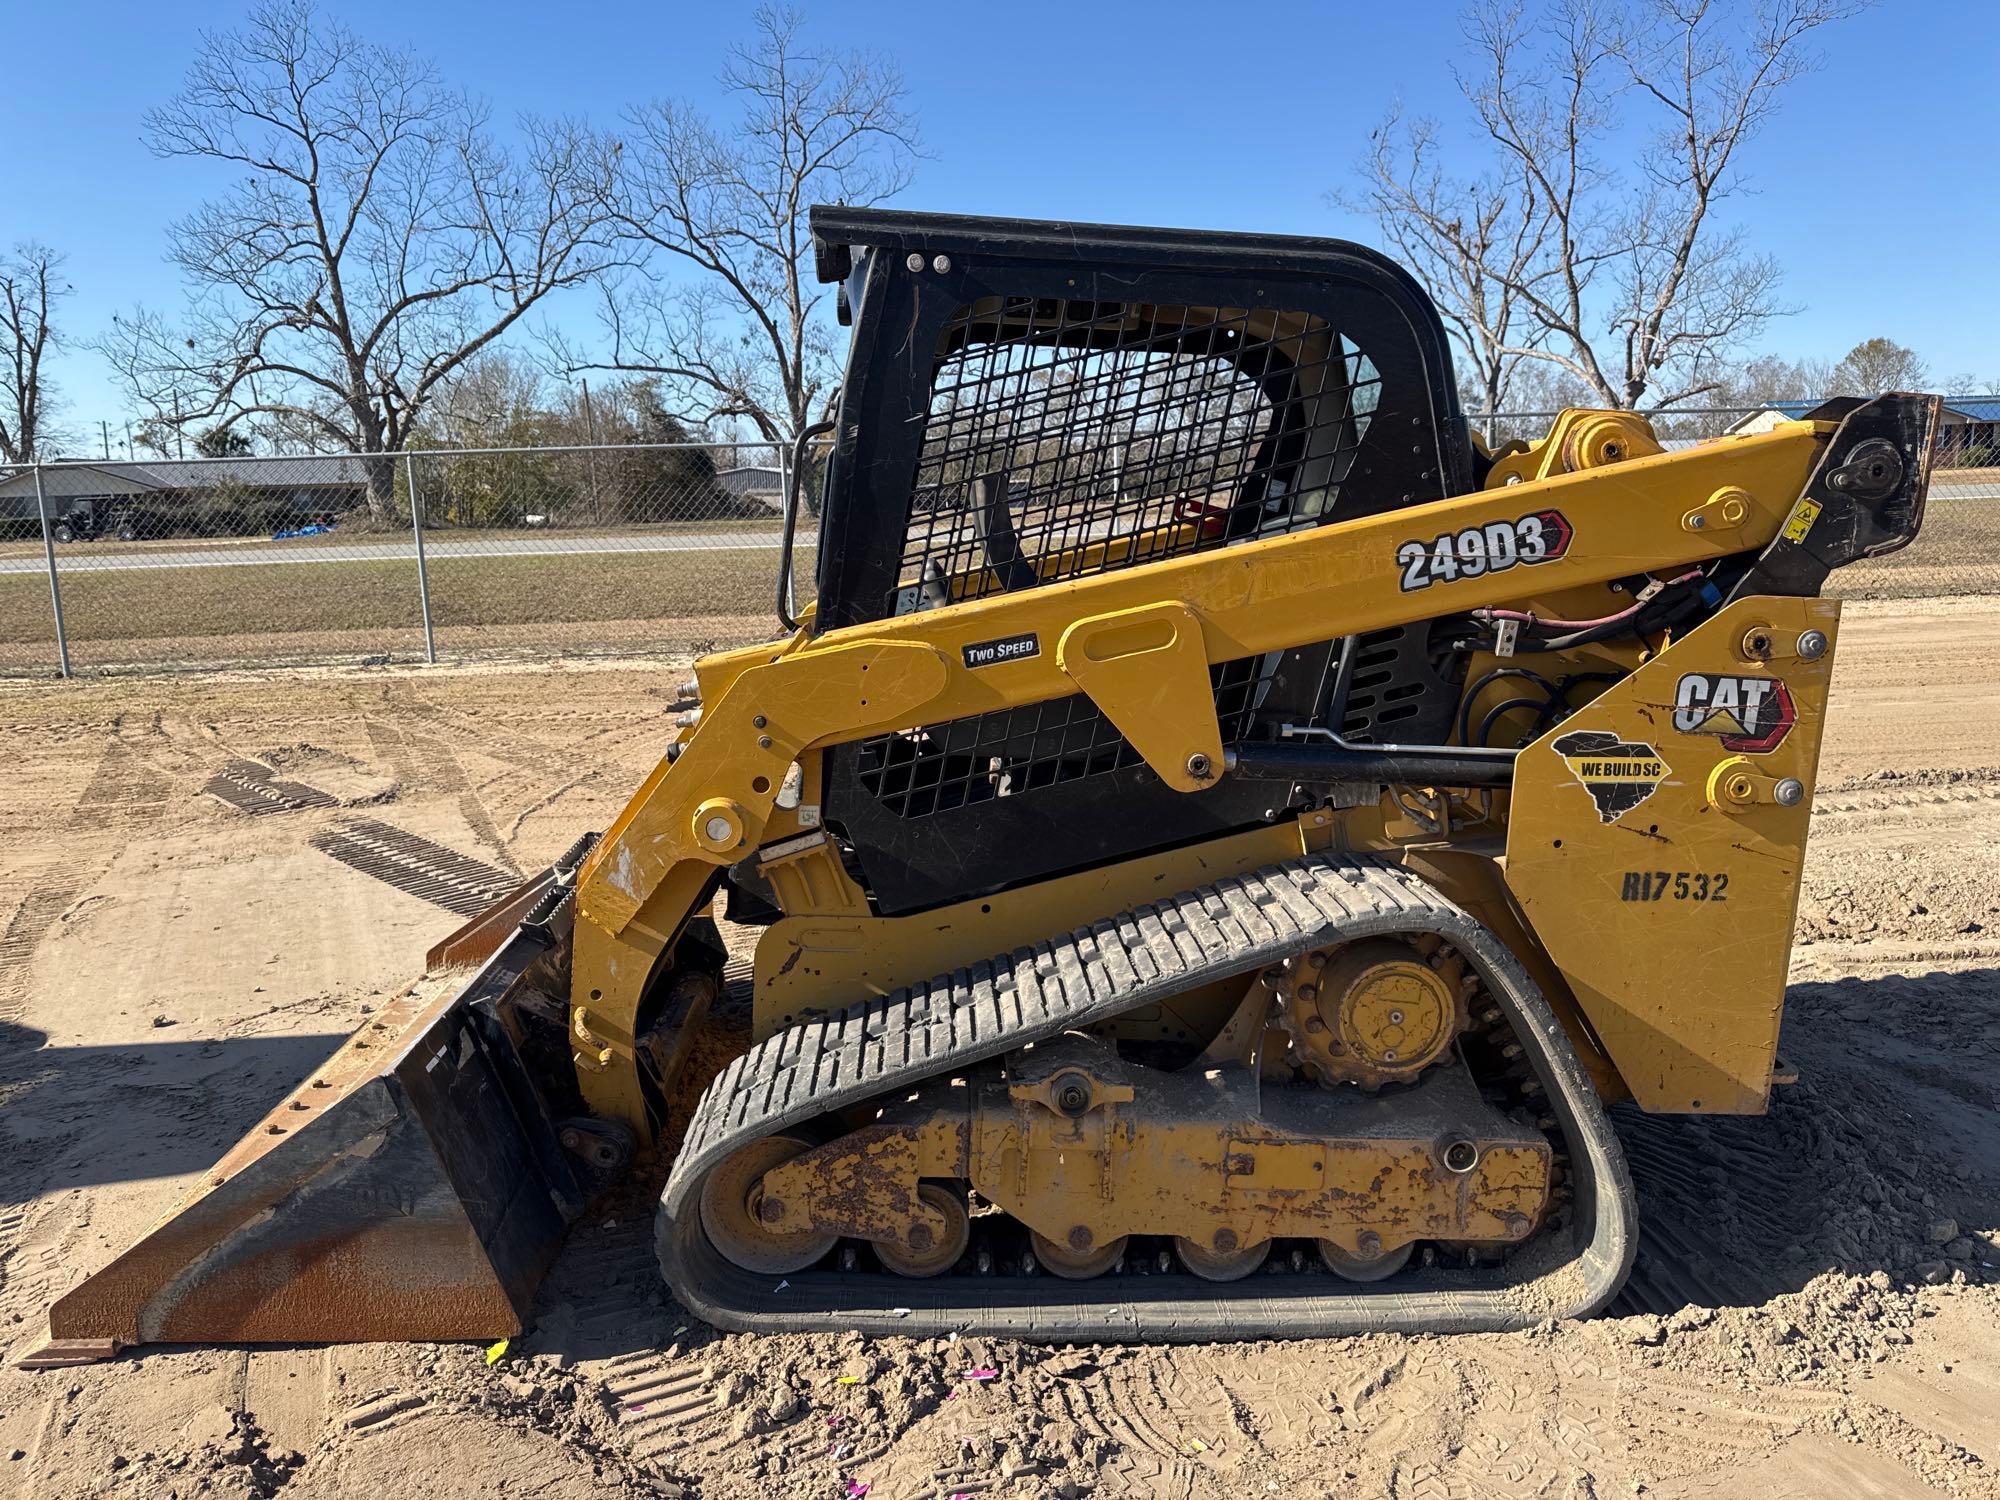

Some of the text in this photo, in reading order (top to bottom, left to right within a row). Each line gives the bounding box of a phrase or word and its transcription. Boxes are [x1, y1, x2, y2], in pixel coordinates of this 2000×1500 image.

[1399, 516, 1546, 589] 249D3
[1676, 675, 1770, 735] CAT
[1582, 763, 1660, 776] WE BUILD SC
